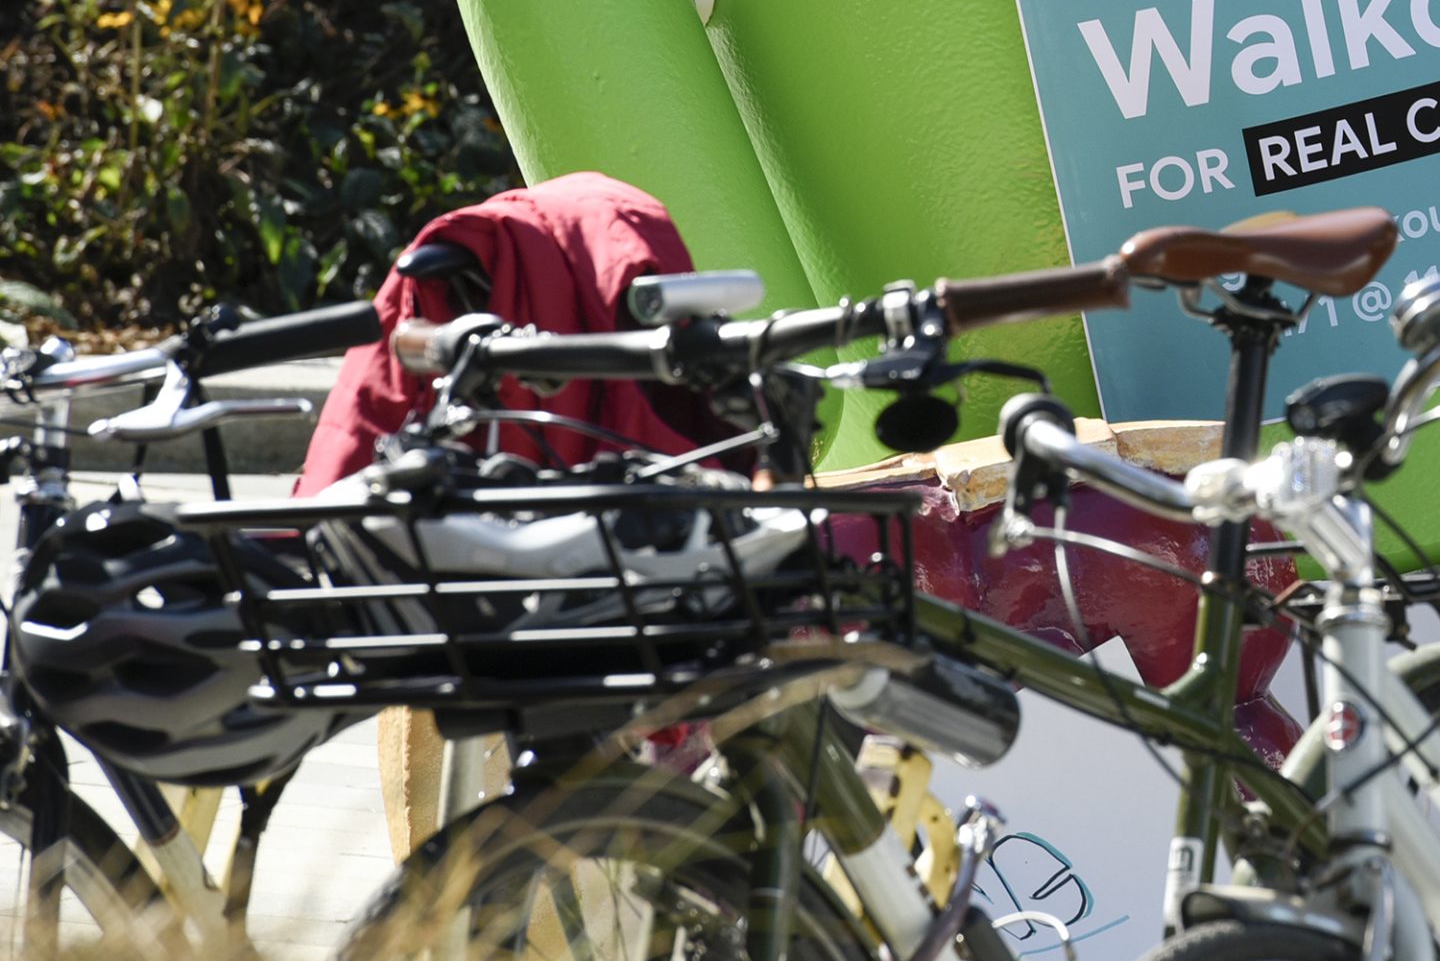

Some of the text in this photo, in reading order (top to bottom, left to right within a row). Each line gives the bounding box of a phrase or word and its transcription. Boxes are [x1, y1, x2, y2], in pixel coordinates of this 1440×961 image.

[1115, 147, 1235, 208] FOR
[1257, 111, 1397, 180] REAL
[1352, 281, 1392, 322] @
